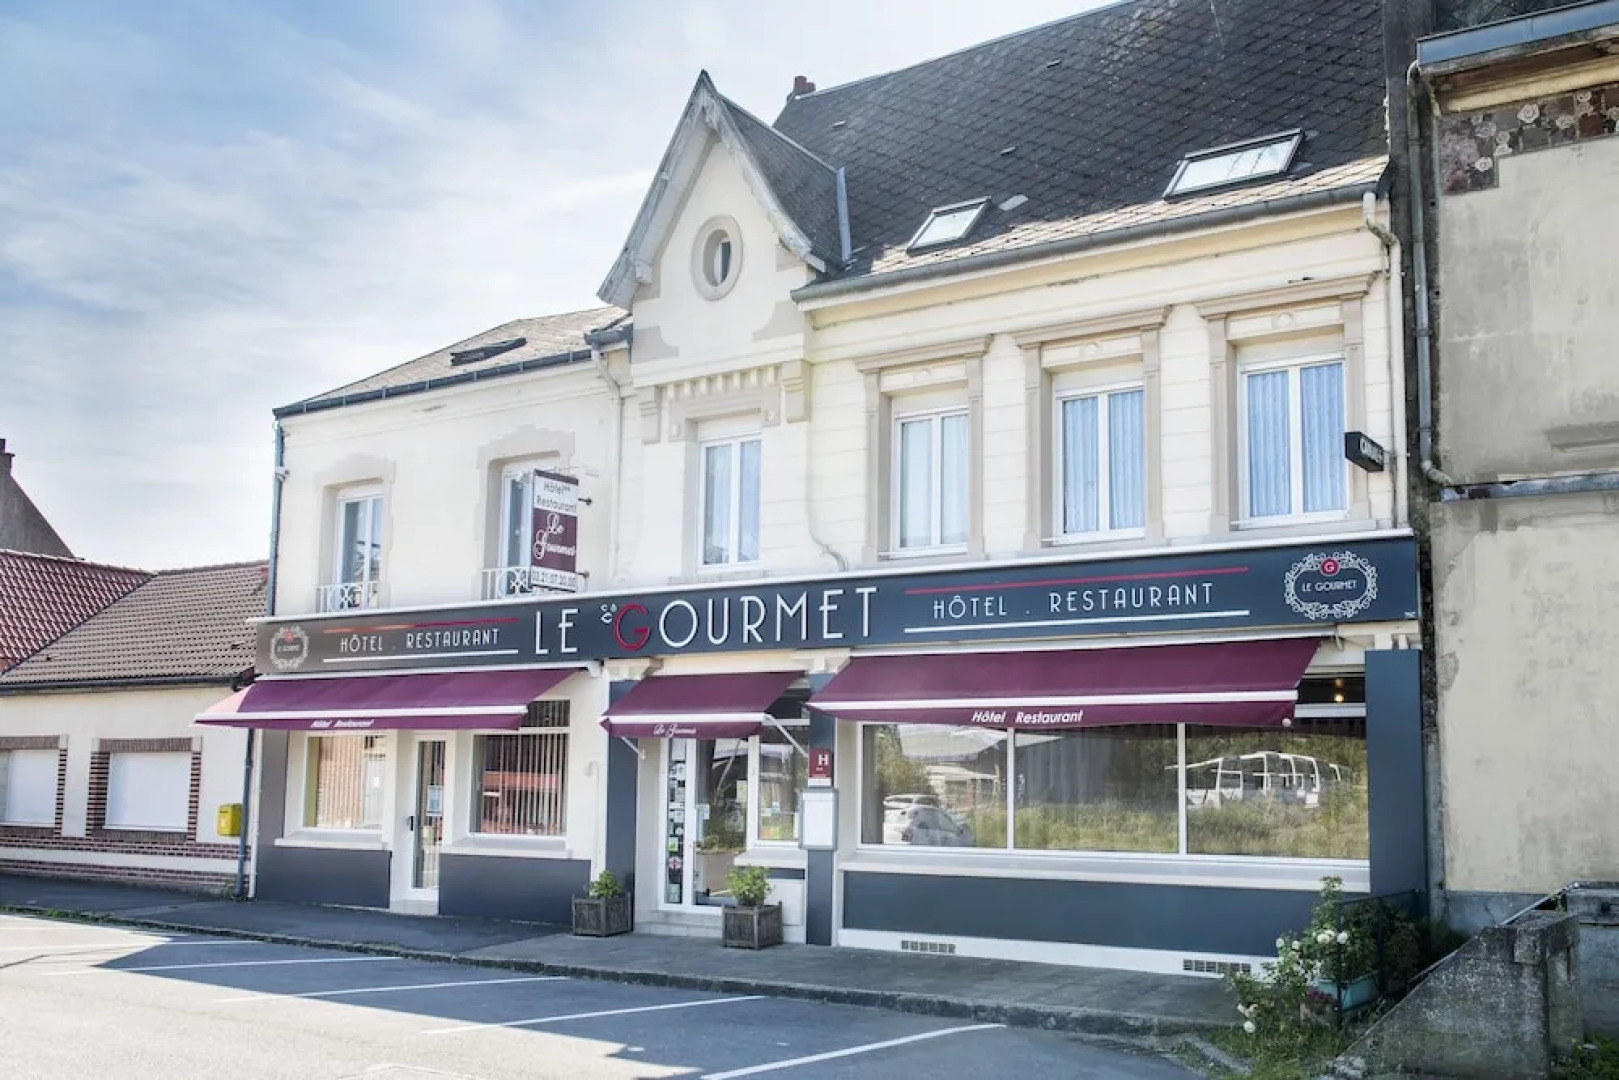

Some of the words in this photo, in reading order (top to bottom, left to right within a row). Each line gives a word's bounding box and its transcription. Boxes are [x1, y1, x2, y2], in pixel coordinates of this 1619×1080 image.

[1301, 582, 1312, 593] LE
[1314, 579, 1358, 592] GOURMET
[932, 593, 1008, 619] HÔTEL
[1049, 582, 1214, 613] RESTAURANT
[535, 608, 579, 655] LE
[614, 587, 877, 652] GOURMET
[340, 634, 383, 652] HÔTEL
[405, 628, 500, 649] RESTAURANT
[971, 709, 1007, 723] Hôtel
[1014, 708, 1084, 724] Restaurant
[818, 754, 829, 765] H
